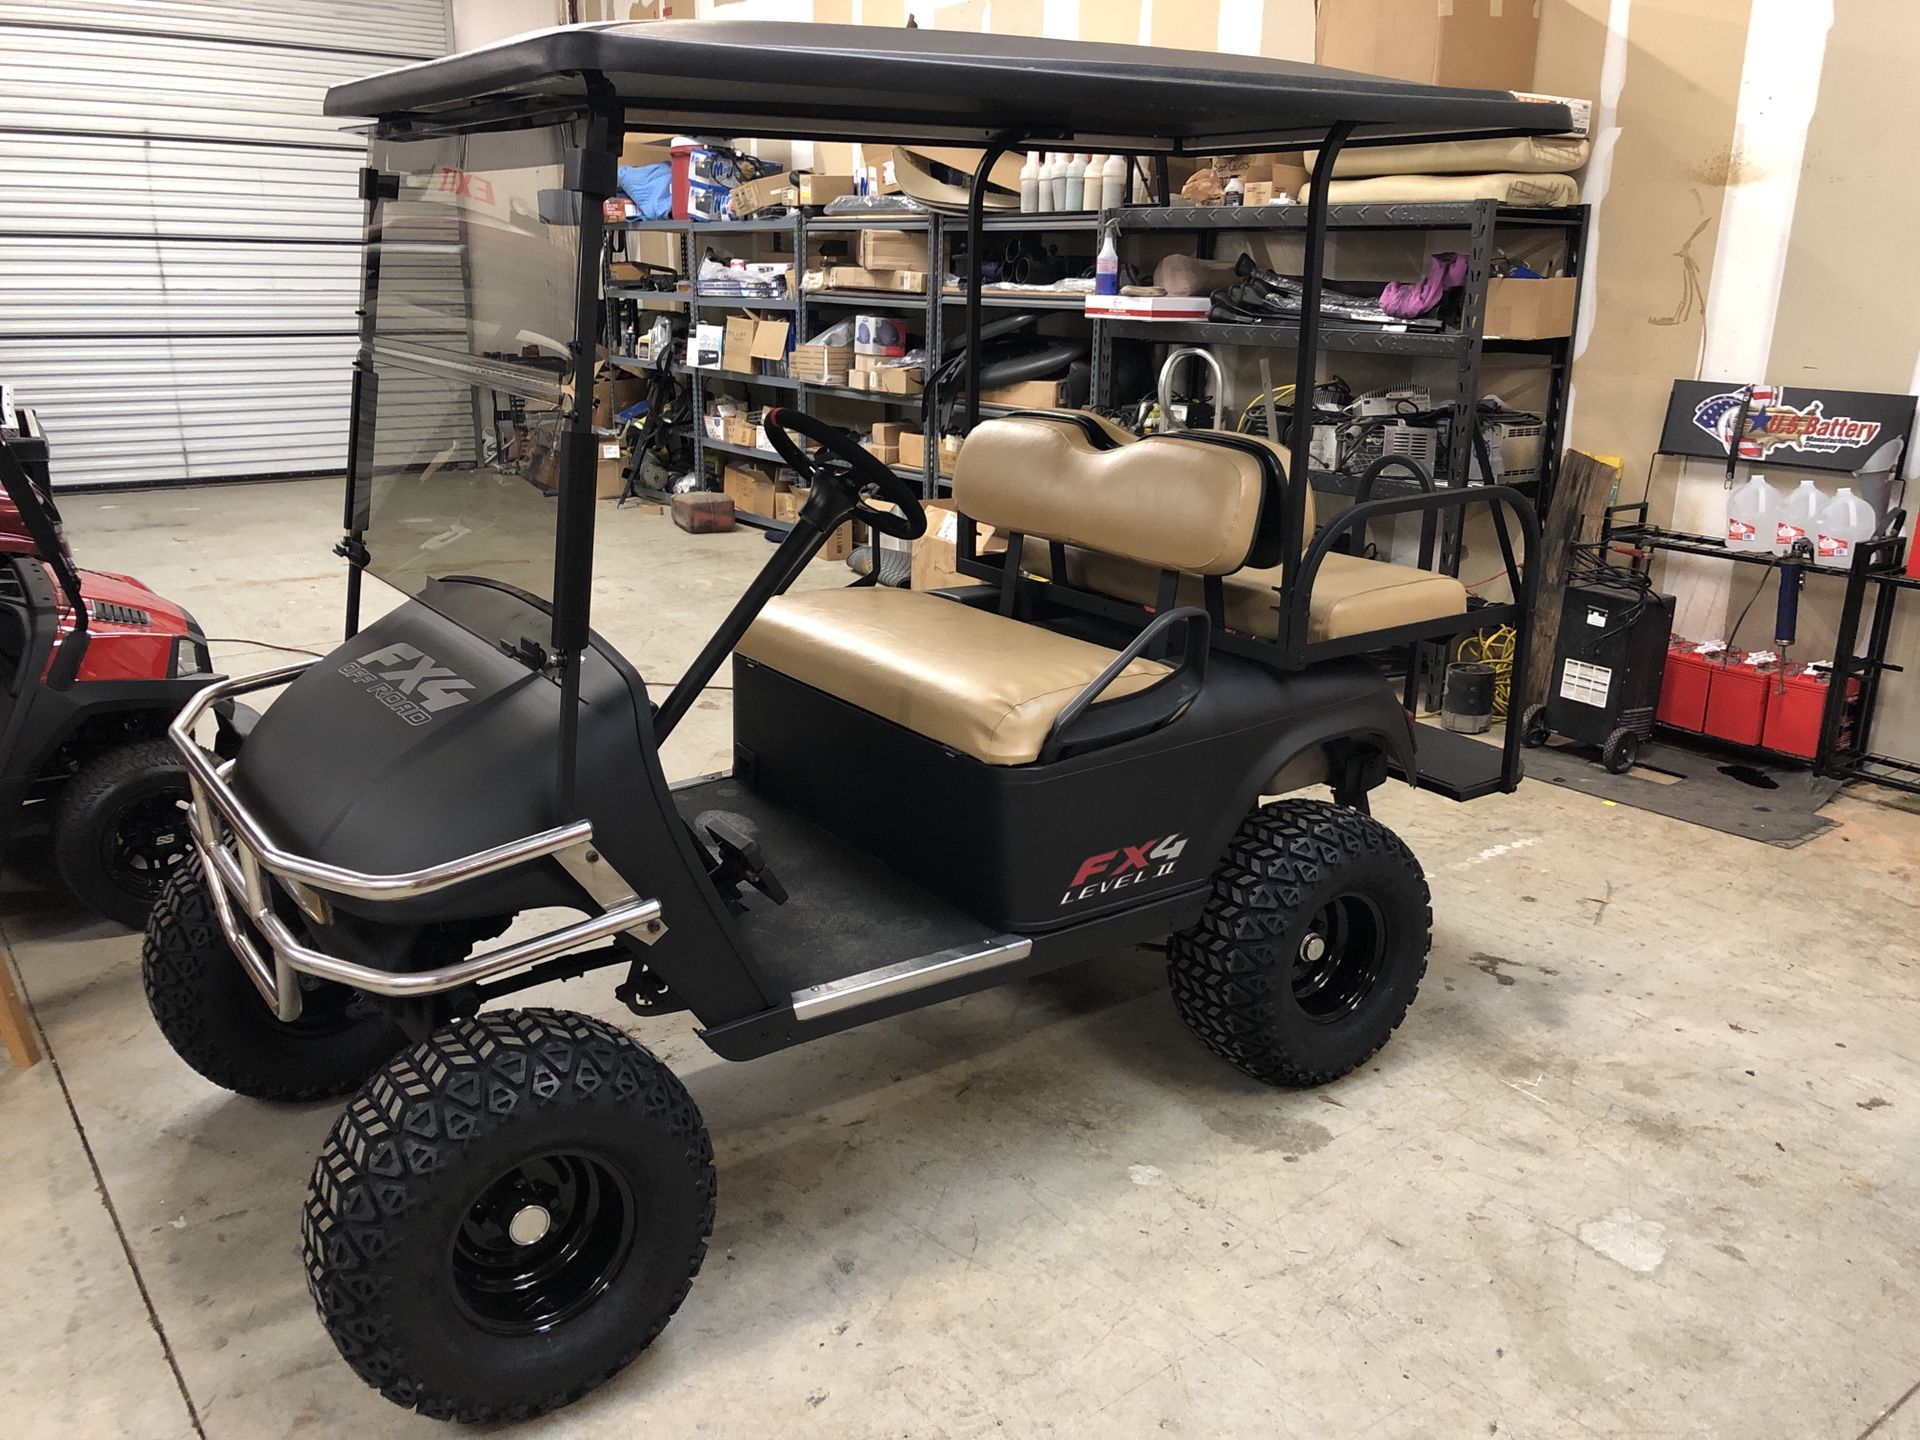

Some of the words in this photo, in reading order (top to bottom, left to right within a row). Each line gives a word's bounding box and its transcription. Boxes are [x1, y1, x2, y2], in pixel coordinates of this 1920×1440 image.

[1768, 415, 1800, 434] U.S.
[1804, 415, 1879, 442] Battery
[1805, 436, 1861, 446] Manufacturing
[1804, 442, 1838, 451] Company
[337, 661, 378, 684] OFF
[366, 682, 433, 727] ROAD
[356, 642, 476, 713] FX4
[1069, 832, 1189, 888] FX4
[1058, 871, 1146, 906] LEVEL
